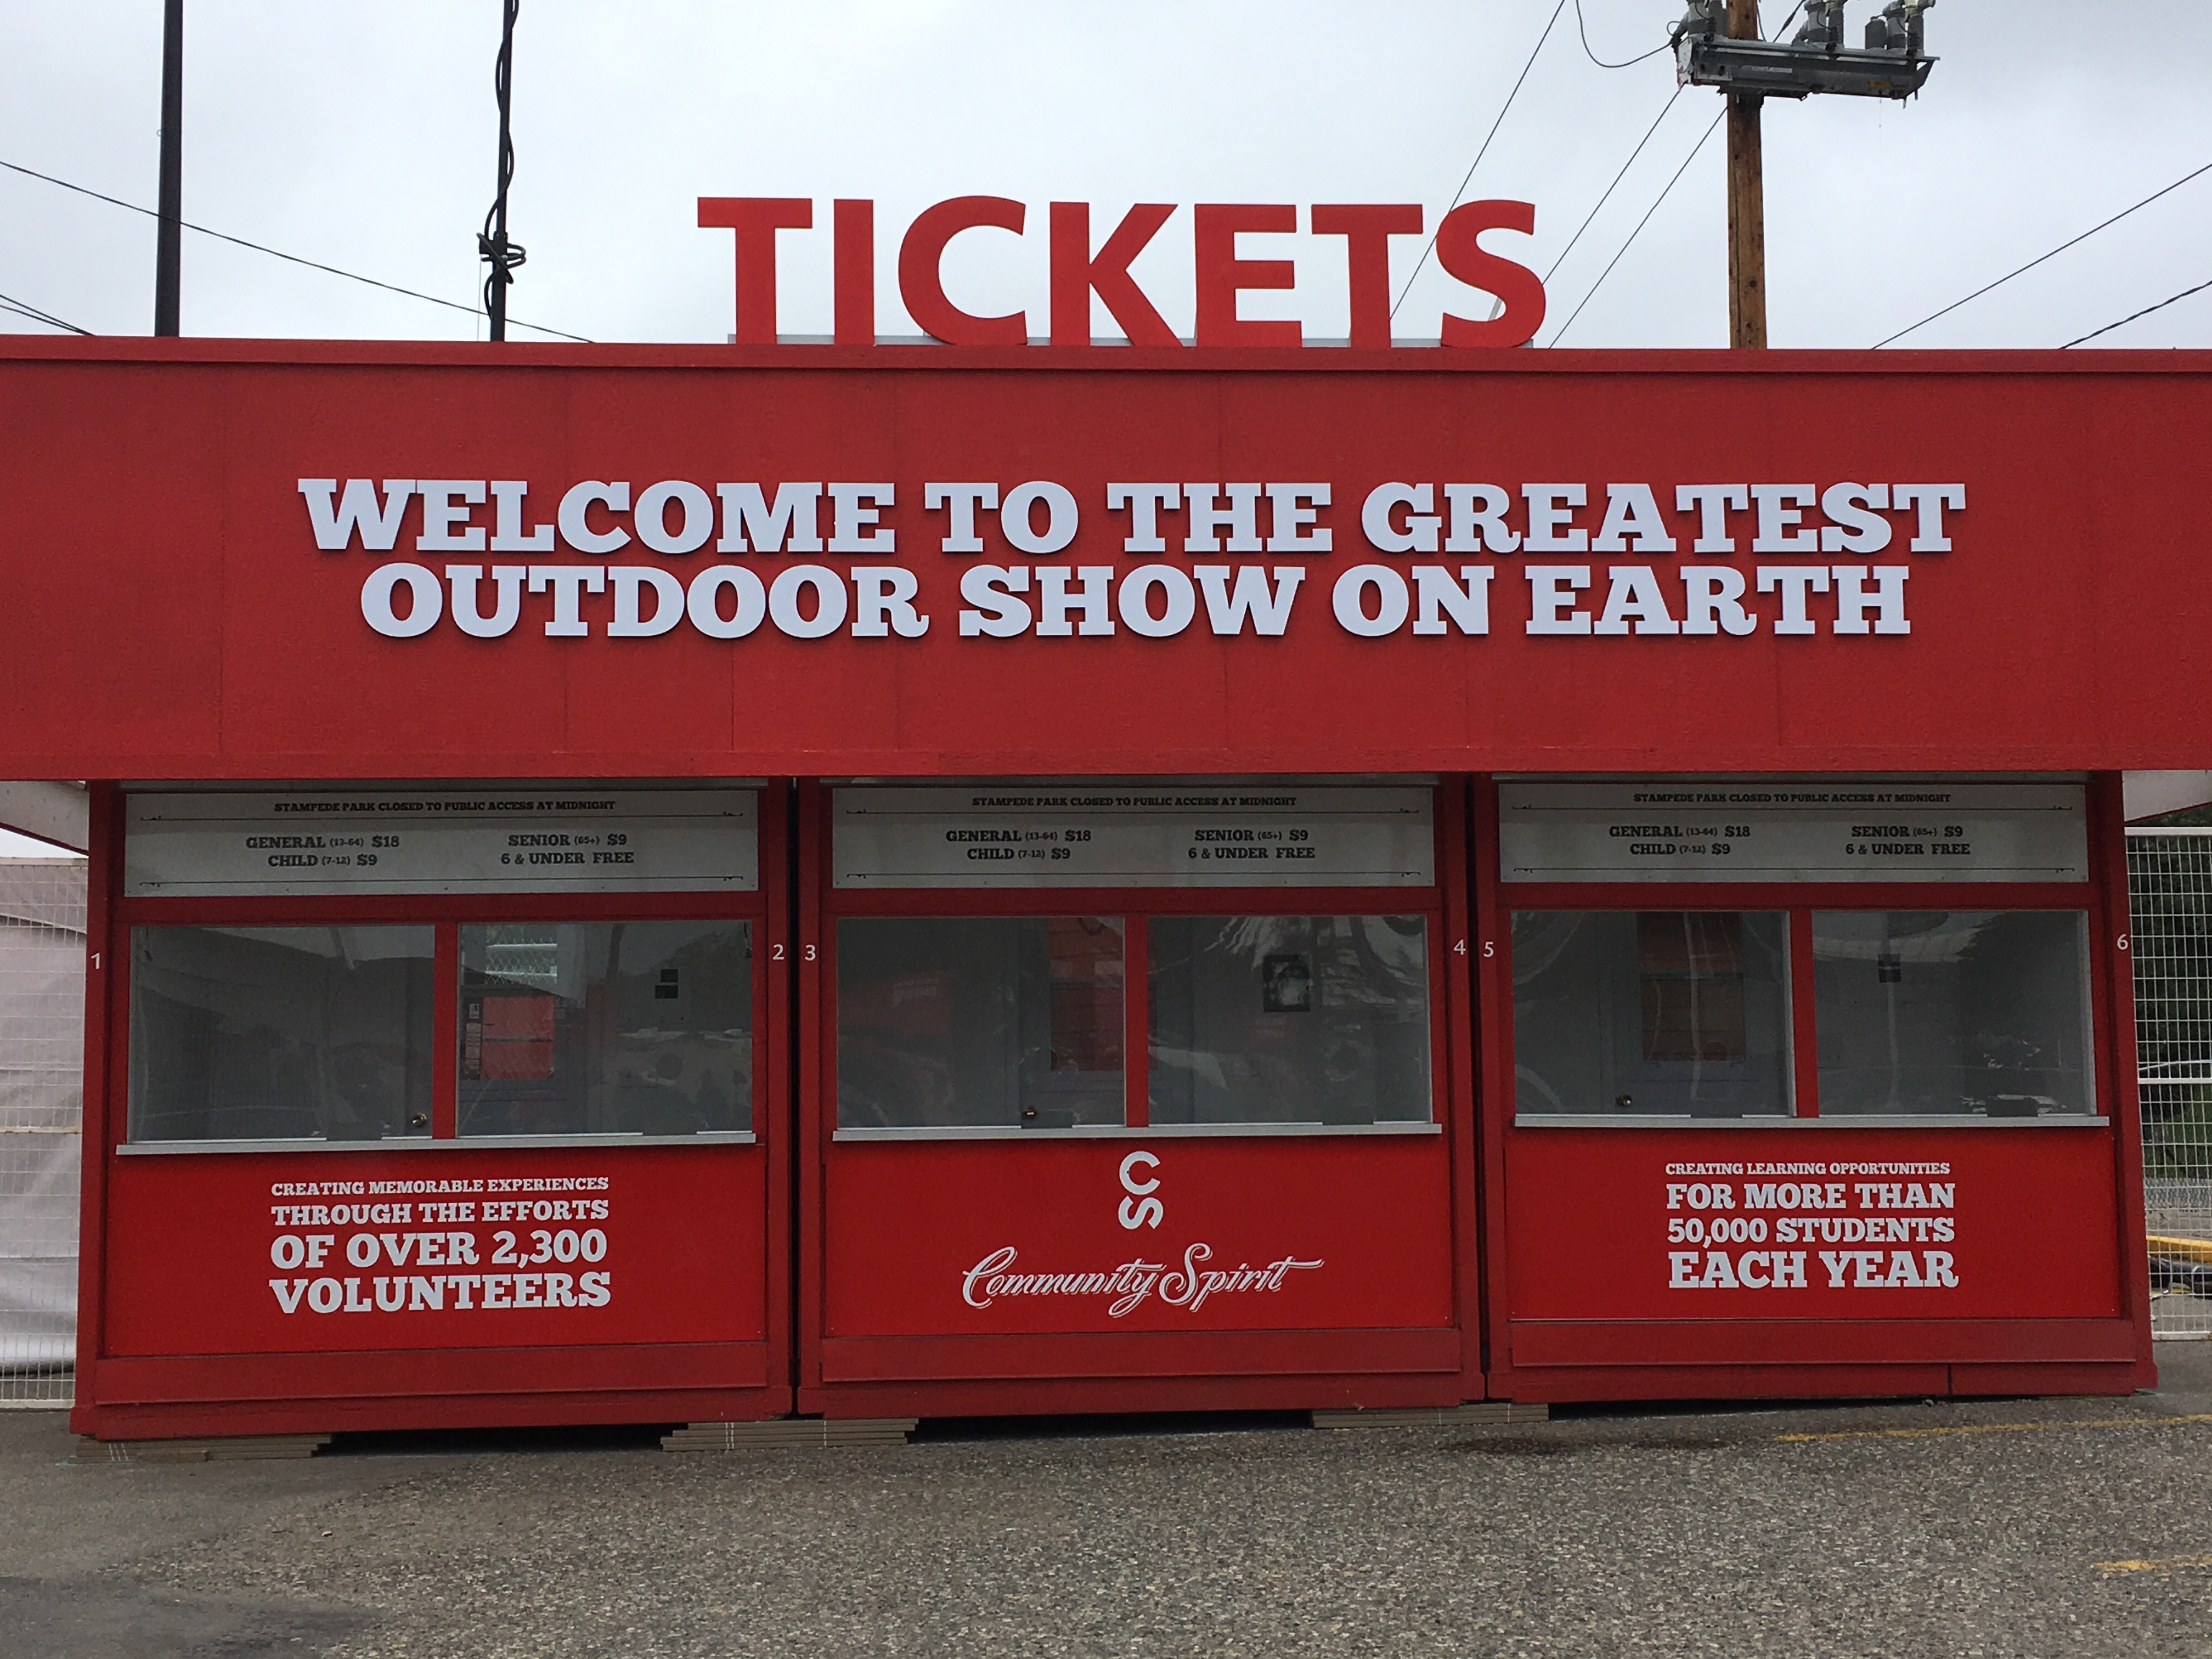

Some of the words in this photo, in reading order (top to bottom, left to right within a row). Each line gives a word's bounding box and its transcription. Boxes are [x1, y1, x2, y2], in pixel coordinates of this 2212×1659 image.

[697, 195, 1547, 348] TICKETS
[298, 478, 895, 553] WELCOME
[924, 481, 1079, 553] TO
[1107, 482, 1333, 552] THE
[1361, 482, 1966, 553] GREATEST
[360, 562, 929, 639] OUTDOOR
[959, 564, 1306, 637] SHOW
[1332, 565, 1494, 636] ON
[1525, 566, 1911, 636] EARTH
[274, 803, 340, 812] STAMPEDE
[343, 803, 375, 811] PARK
[378, 803, 424, 811] CLOSED
[426, 802, 441, 810] TO
[444, 802, 485, 810] PUBLIC
[488, 802, 534, 810] ACCESS
[537, 801, 554, 809] AT
[556, 800, 616, 809] MIDNIGHT
[972, 797, 1034, 806] STAMPEDE
[1036, 797, 1068, 806] PARK
[1070, 797, 1113, 806] CLOSED
[1116, 797, 1130, 806] TO
[1133, 797, 1172, 806] PUBLIC
[1175, 797, 1218, 805] ACCESS
[1221, 797, 1237, 805] AT
[1240, 797, 1296, 805] MIDNIGHT
[1634, 793, 1694, 803] STAMPEDE
[1696, 793, 1727, 802] PARK
[1729, 793, 1771, 802] CLOSED
[1773, 794, 1788, 802] TO
[1791, 794, 1829, 802] PUBLIC
[1831, 794, 1874, 802] ACCESS
[1877, 794, 1893, 802] AT
[1895, 794, 1951, 802] MIDNIGHT
[946, 830, 1022, 842] GENERAL
[1065, 830, 1091, 842] $18
[1194, 830, 1254, 841] SENIOR
[1289, 829, 1308, 842] $9
[1609, 826, 1683, 838] GENERAL
[1724, 825, 1751, 838] $18
[1852, 826, 1910, 838] SENIOR
[1944, 825, 1963, 838] $9
[246, 837, 326, 849] GENERAL
[371, 835, 399, 848] $18
[508, 834, 570, 847] SENIOR
[607, 833, 627, 847] $9
[967, 848, 1015, 860] CHILD
[1051, 847, 1070, 860] $9
[1188, 848, 1197, 859] 6
[1201, 848, 1211, 859] &
[1215, 848, 1268, 859] UNDER
[1276, 848, 1315, 859] FREE
[1629, 843, 1676, 855] CHILD
[1711, 843, 1731, 855] $9
[1845, 844, 1854, 855] 6
[1858, 844, 1867, 855] &
[1871, 843, 1925, 855] UNDER
[1931, 843, 1971, 855] FREE
[268, 854, 318, 867] CHILD
[357, 854, 377, 866] $9
[501, 853, 510, 865] 6
[515, 854, 524, 865] &
[529, 852, 585, 864] UNDER
[592, 851, 634, 864] FREE
[1454, 939, 1466, 955] 4
[1483, 941, 1494, 957] 5
[2117, 934, 2128, 950] 6
[772, 944, 784, 960] 2
[805, 944, 816, 961] 3
[92, 953, 100, 969] 1
[1666, 1163, 1743, 1175] CREATING
[1747, 1163, 1826, 1175] LEARNING
[1830, 1162, 1950, 1175] OPPORTUNITIES
[272, 1182, 365, 1197] CREATING
[369, 1179, 483, 1194] MEMORABLE
[487, 1177, 609, 1193] EXPERIENCES
[1666, 1183, 1736, 1209] FOR
[1743, 1183, 1846, 1209] MORE
[1854, 1183, 1955, 1209] THAN
[271, 1204, 411, 1226] THROUGH
[419, 1202, 475, 1223] THE
[482, 1199, 609, 1222] EFFORTS
[1667, 1217, 1768, 1249] 50,000
[1776, 1217, 1955, 1243] STUDENTS
[270, 1233, 335, 1269] OF
[346, 1232, 479, 1268] OVER
[492, 1229, 607, 1269] 2,300
[1668, 1250, 1808, 1289] EACH
[1818, 1250, 1959, 1288] YEAR
[962, 1246, 1167, 1318] Community
[1159, 1243, 1324, 1312] Spirit
[269, 1271, 611, 1314] VOLUNTEERS
